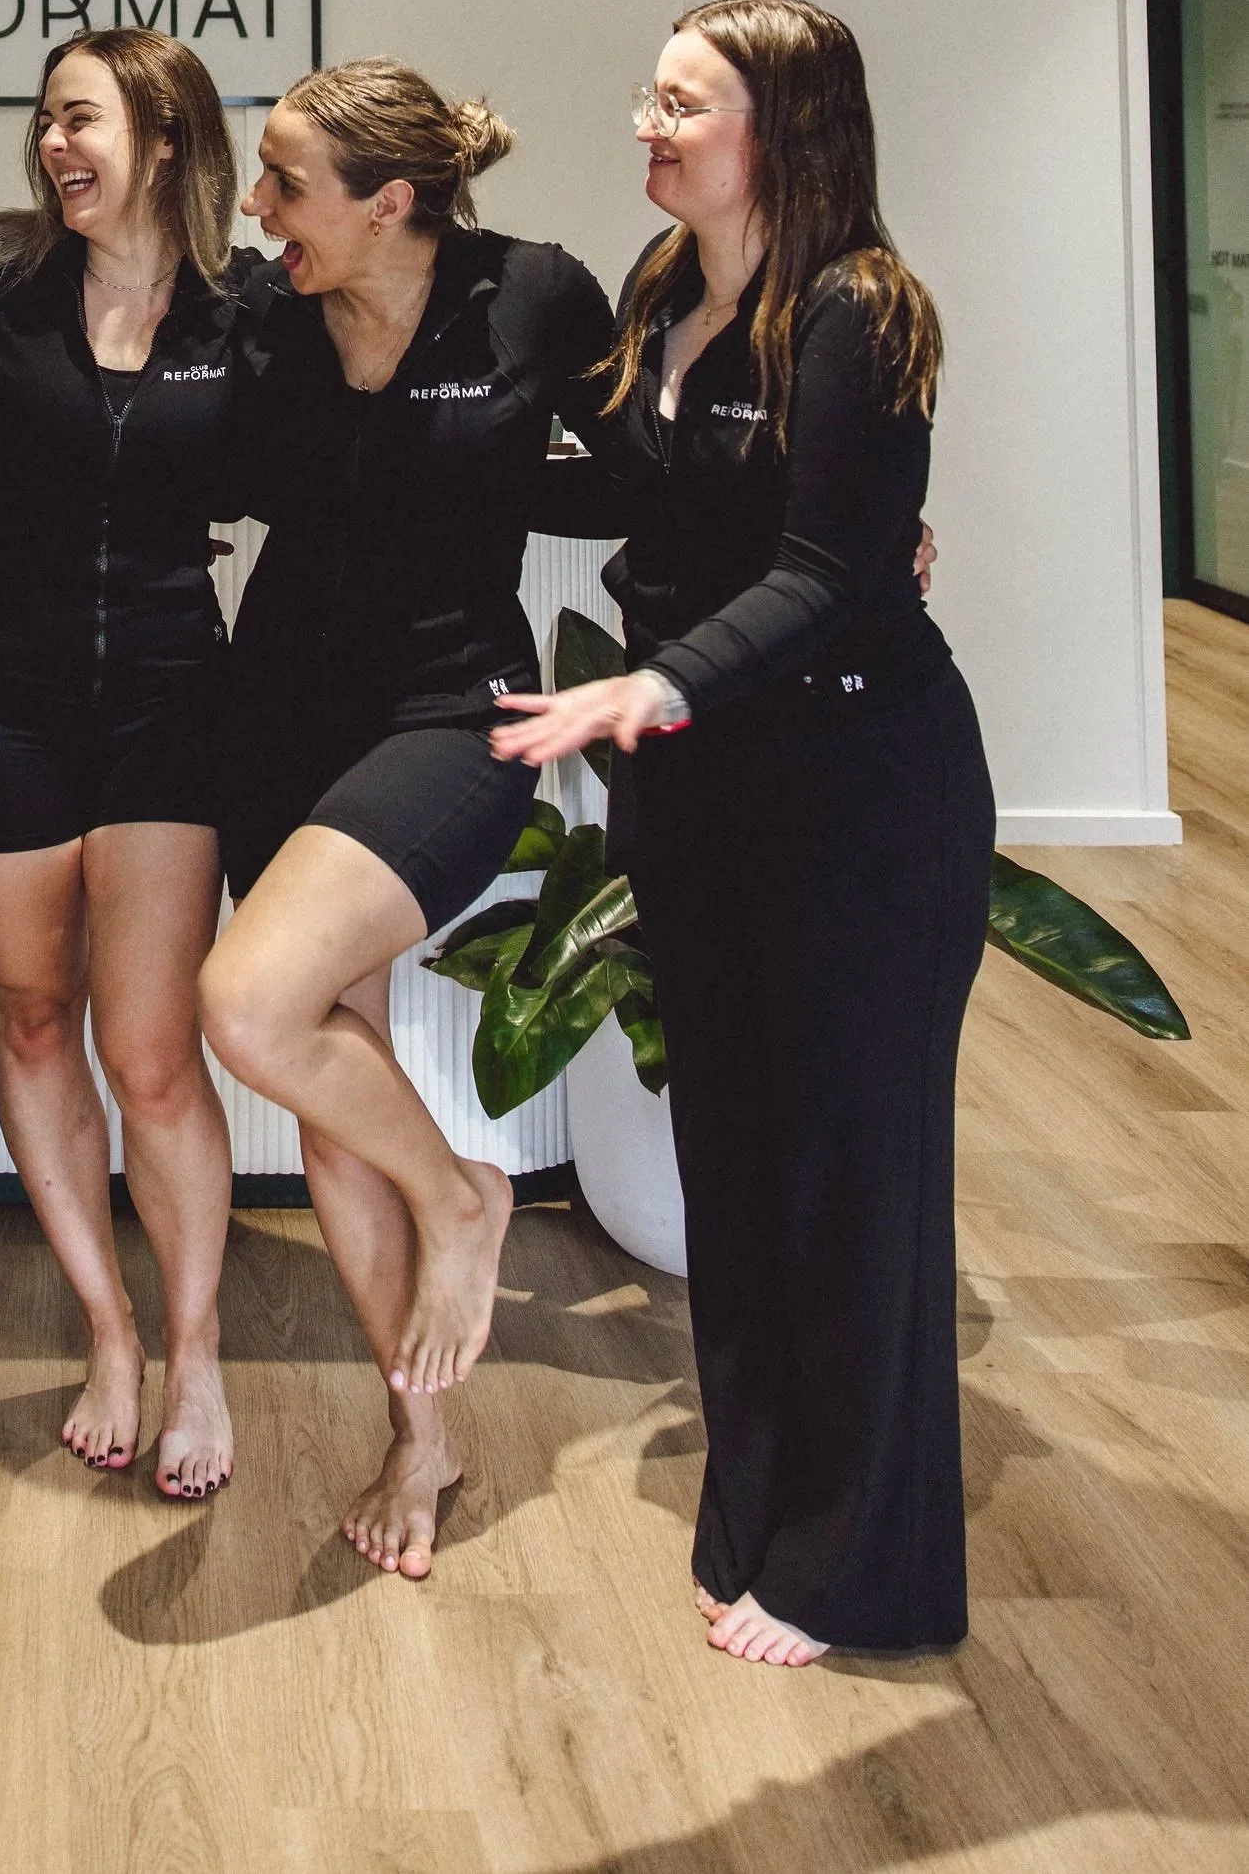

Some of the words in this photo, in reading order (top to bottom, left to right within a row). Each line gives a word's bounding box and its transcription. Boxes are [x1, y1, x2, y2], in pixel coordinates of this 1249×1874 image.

[163, 366, 226, 381] REFORMAT
[190, 364, 209, 372] CLUB
[409, 385, 492, 400] REFORMAT
[732, 400, 752, 409] CLUB
